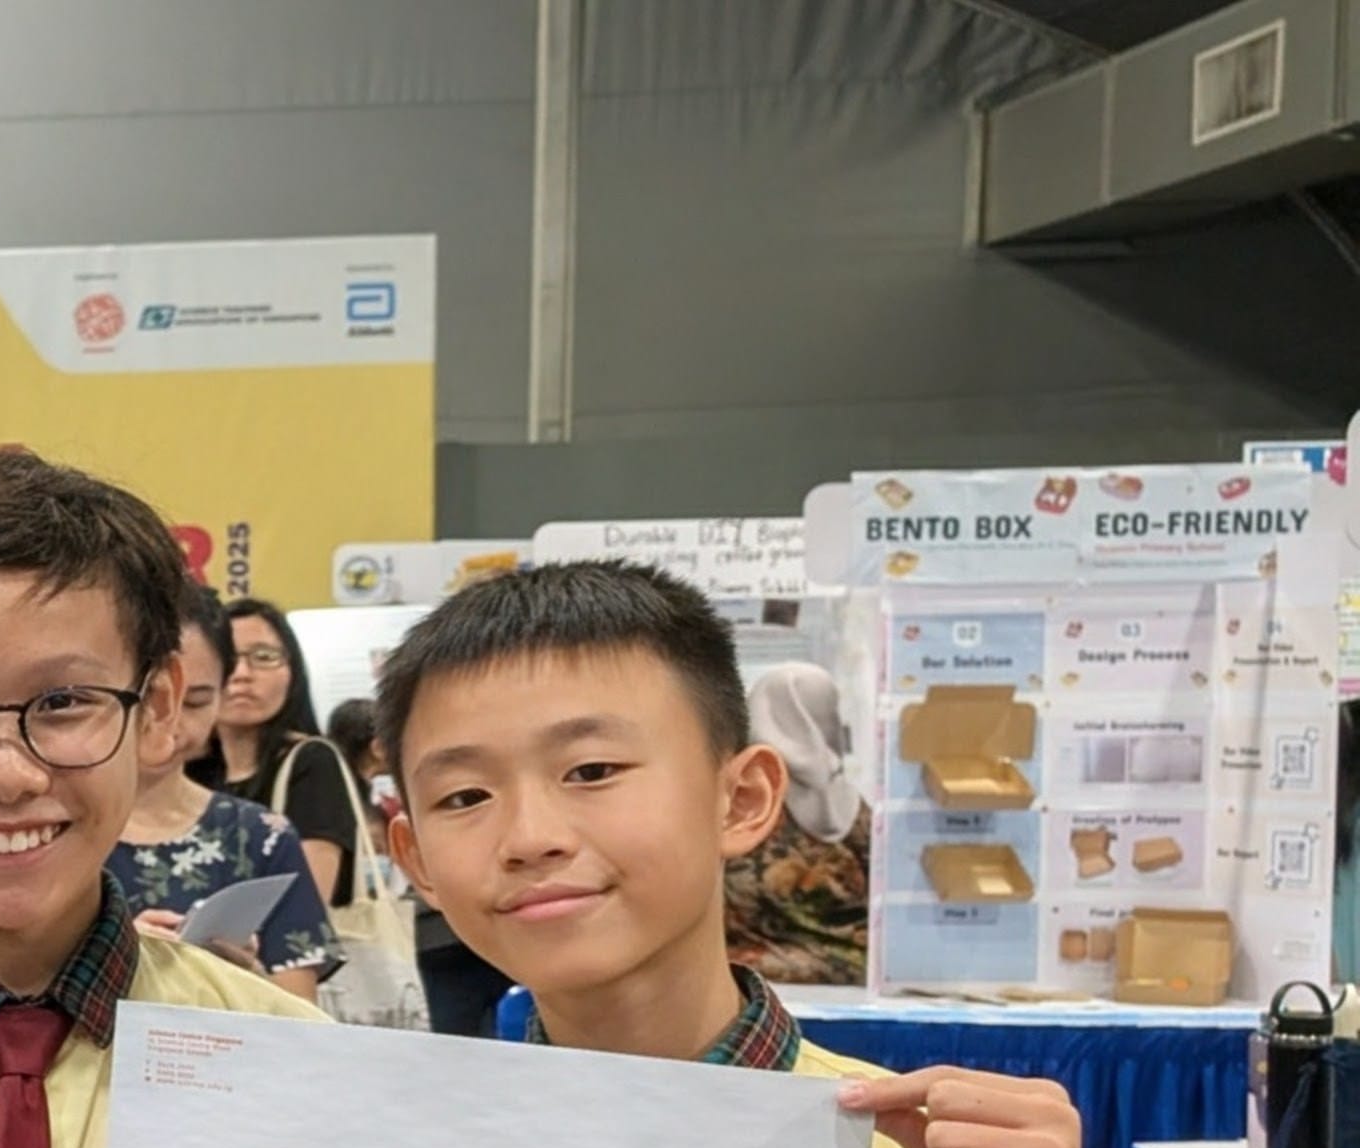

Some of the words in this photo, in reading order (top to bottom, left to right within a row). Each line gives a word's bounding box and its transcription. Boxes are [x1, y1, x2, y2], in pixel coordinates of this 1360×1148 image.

[866, 515, 960, 542] BENTO
[975, 514, 1033, 540] BOX
[1094, 508, 1309, 538] ECO-FRIENDLY
[227, 521, 253, 597] 2025
